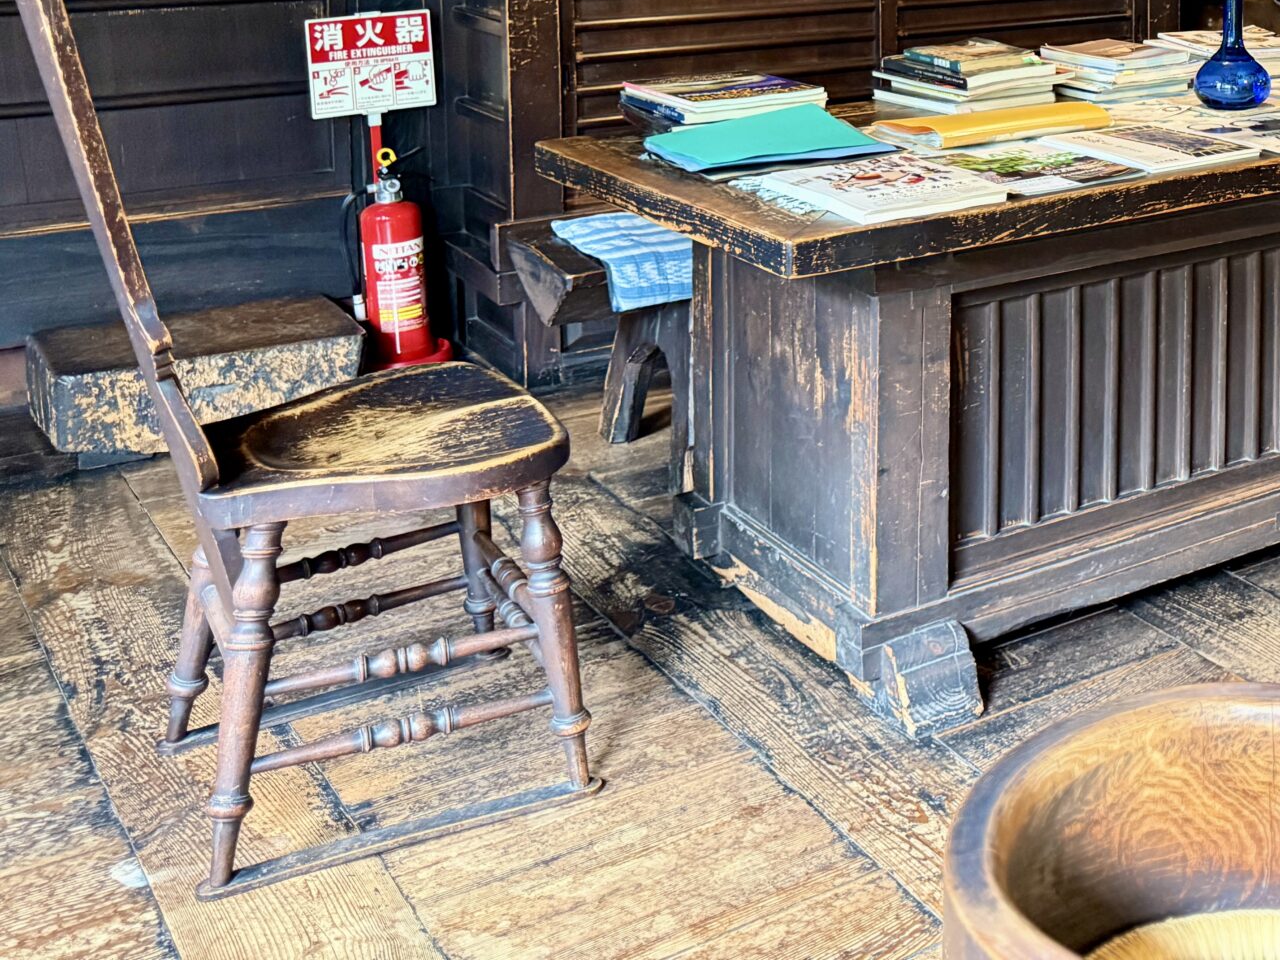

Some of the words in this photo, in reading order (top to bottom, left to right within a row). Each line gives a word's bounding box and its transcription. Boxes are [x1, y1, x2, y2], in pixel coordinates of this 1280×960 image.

[314, 16, 424, 51] 消火器
[329, 50, 348, 60] FIRE
[351, 44, 413, 58] EXTINGUISHER
